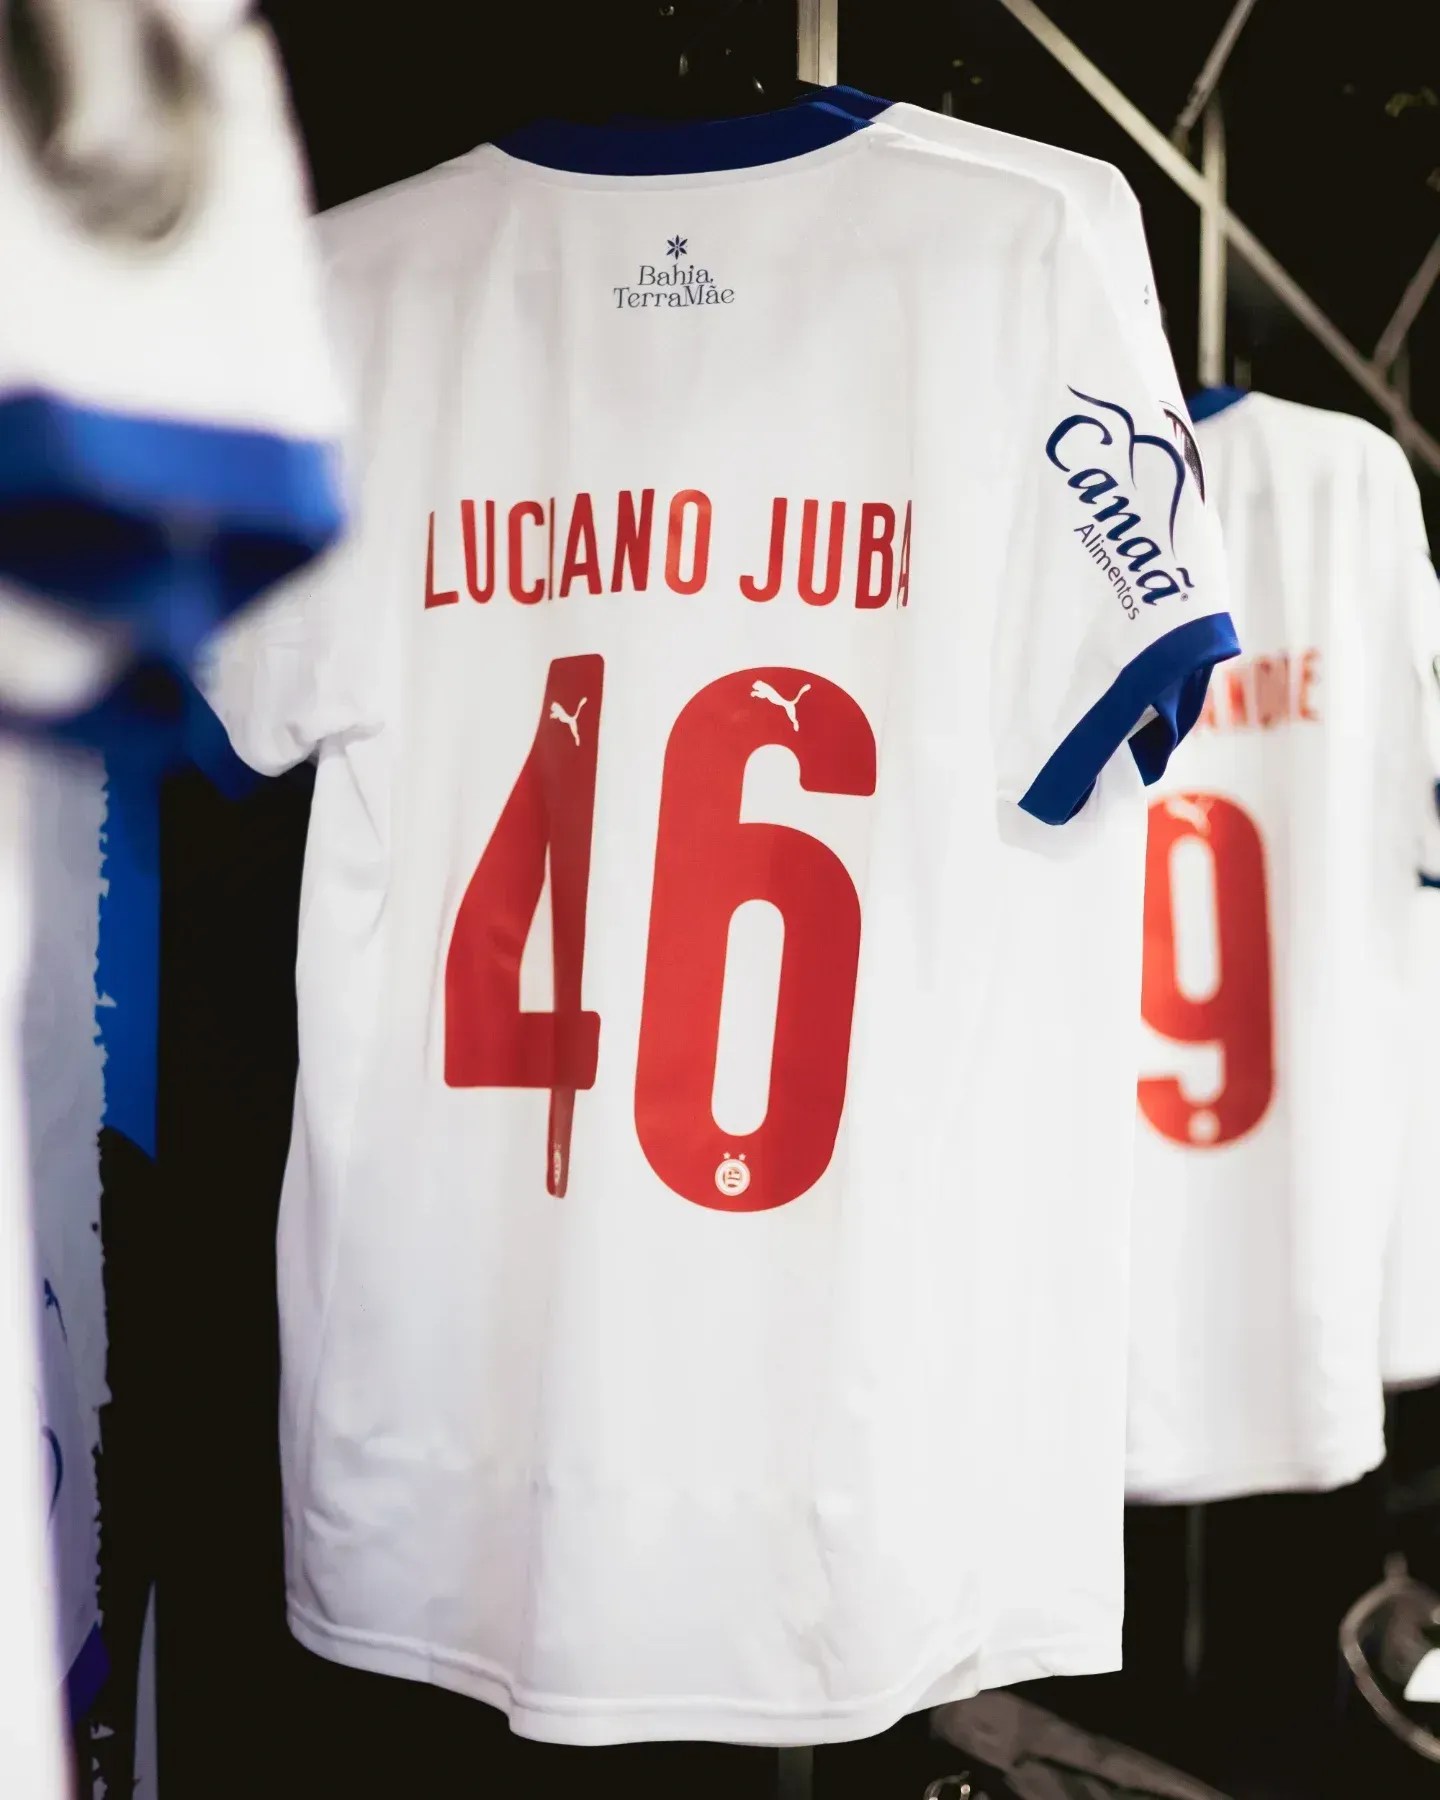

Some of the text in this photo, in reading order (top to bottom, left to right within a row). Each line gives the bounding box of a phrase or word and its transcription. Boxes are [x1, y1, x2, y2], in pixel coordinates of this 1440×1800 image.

[613, 284, 735, 309] TerraMãe
[424, 487, 912, 611] LUCIANO JUBA
[1073, 523, 1140, 621] Alimentos
[442, 653, 878, 1214] 46
[1136, 790, 1279, 1151] 9
